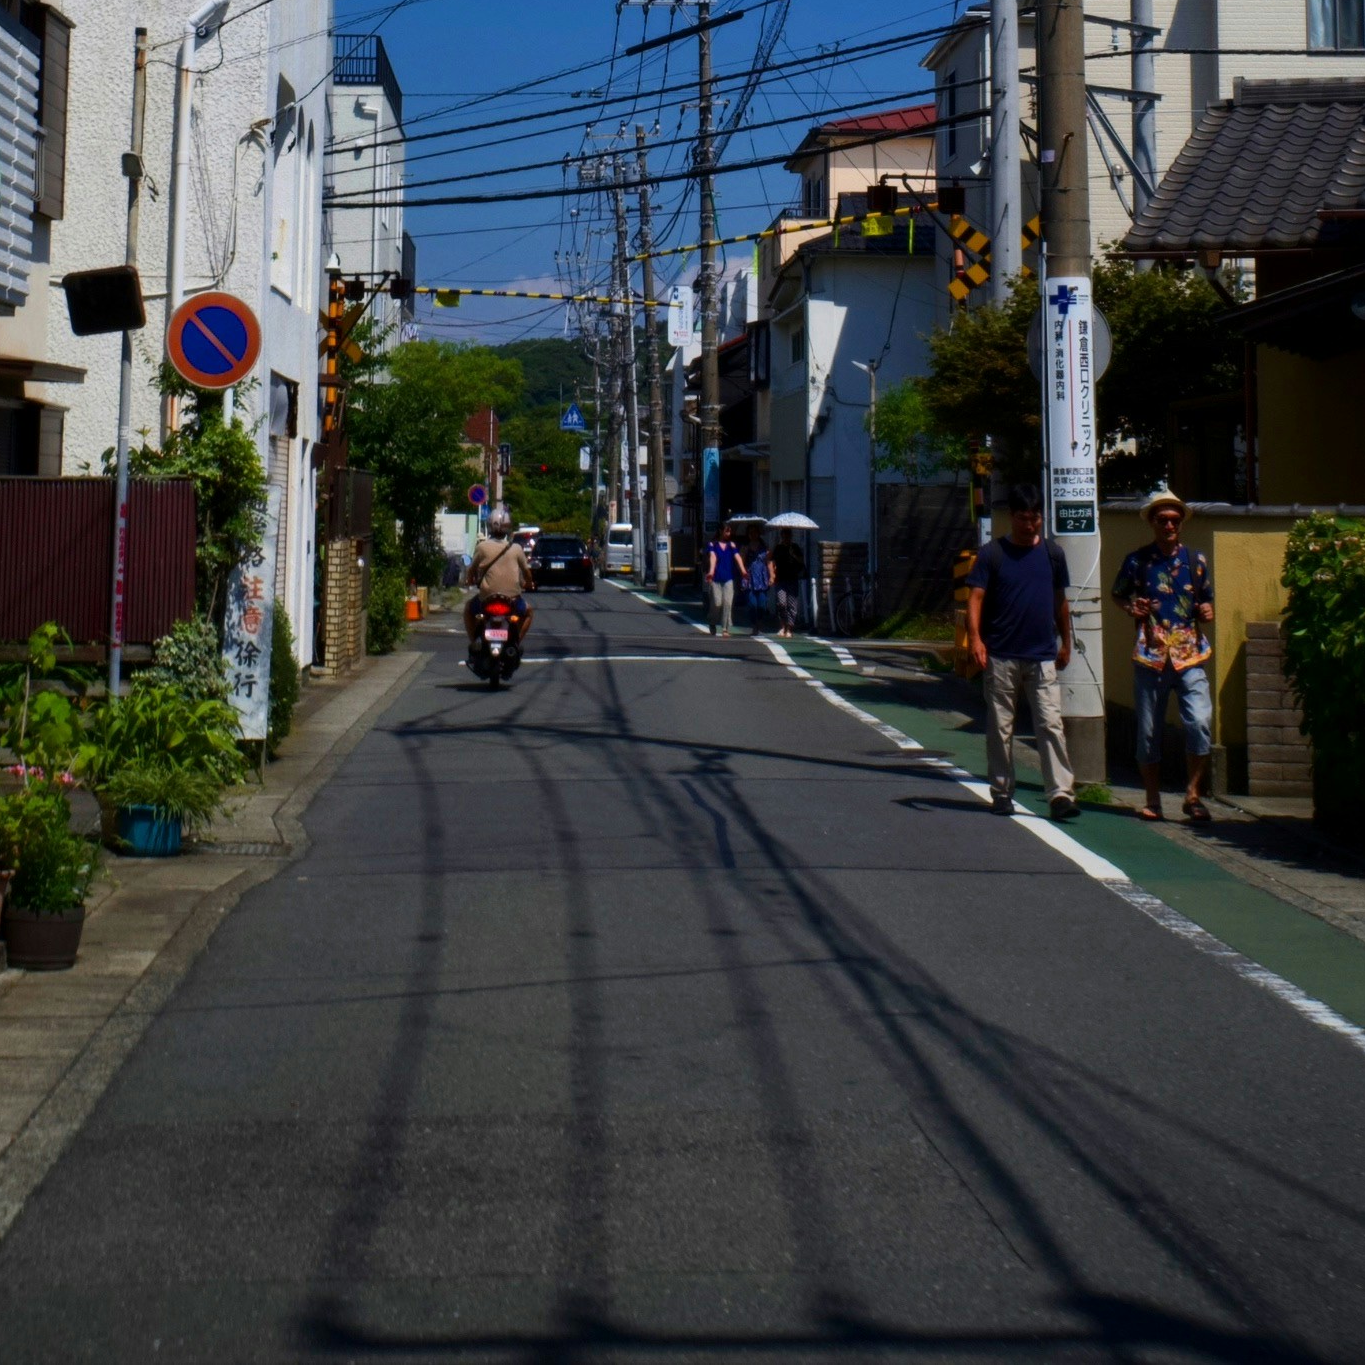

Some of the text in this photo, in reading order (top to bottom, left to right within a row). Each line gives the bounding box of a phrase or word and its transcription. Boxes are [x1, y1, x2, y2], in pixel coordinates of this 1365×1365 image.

[1078, 320, 1092, 457] 鎌倉西口クリニック
[1053, 488, 1095, 497] 22-5657
[1059, 508, 1093, 518] 由比ガ浜
[1066, 520, 1087, 529] 2-7
